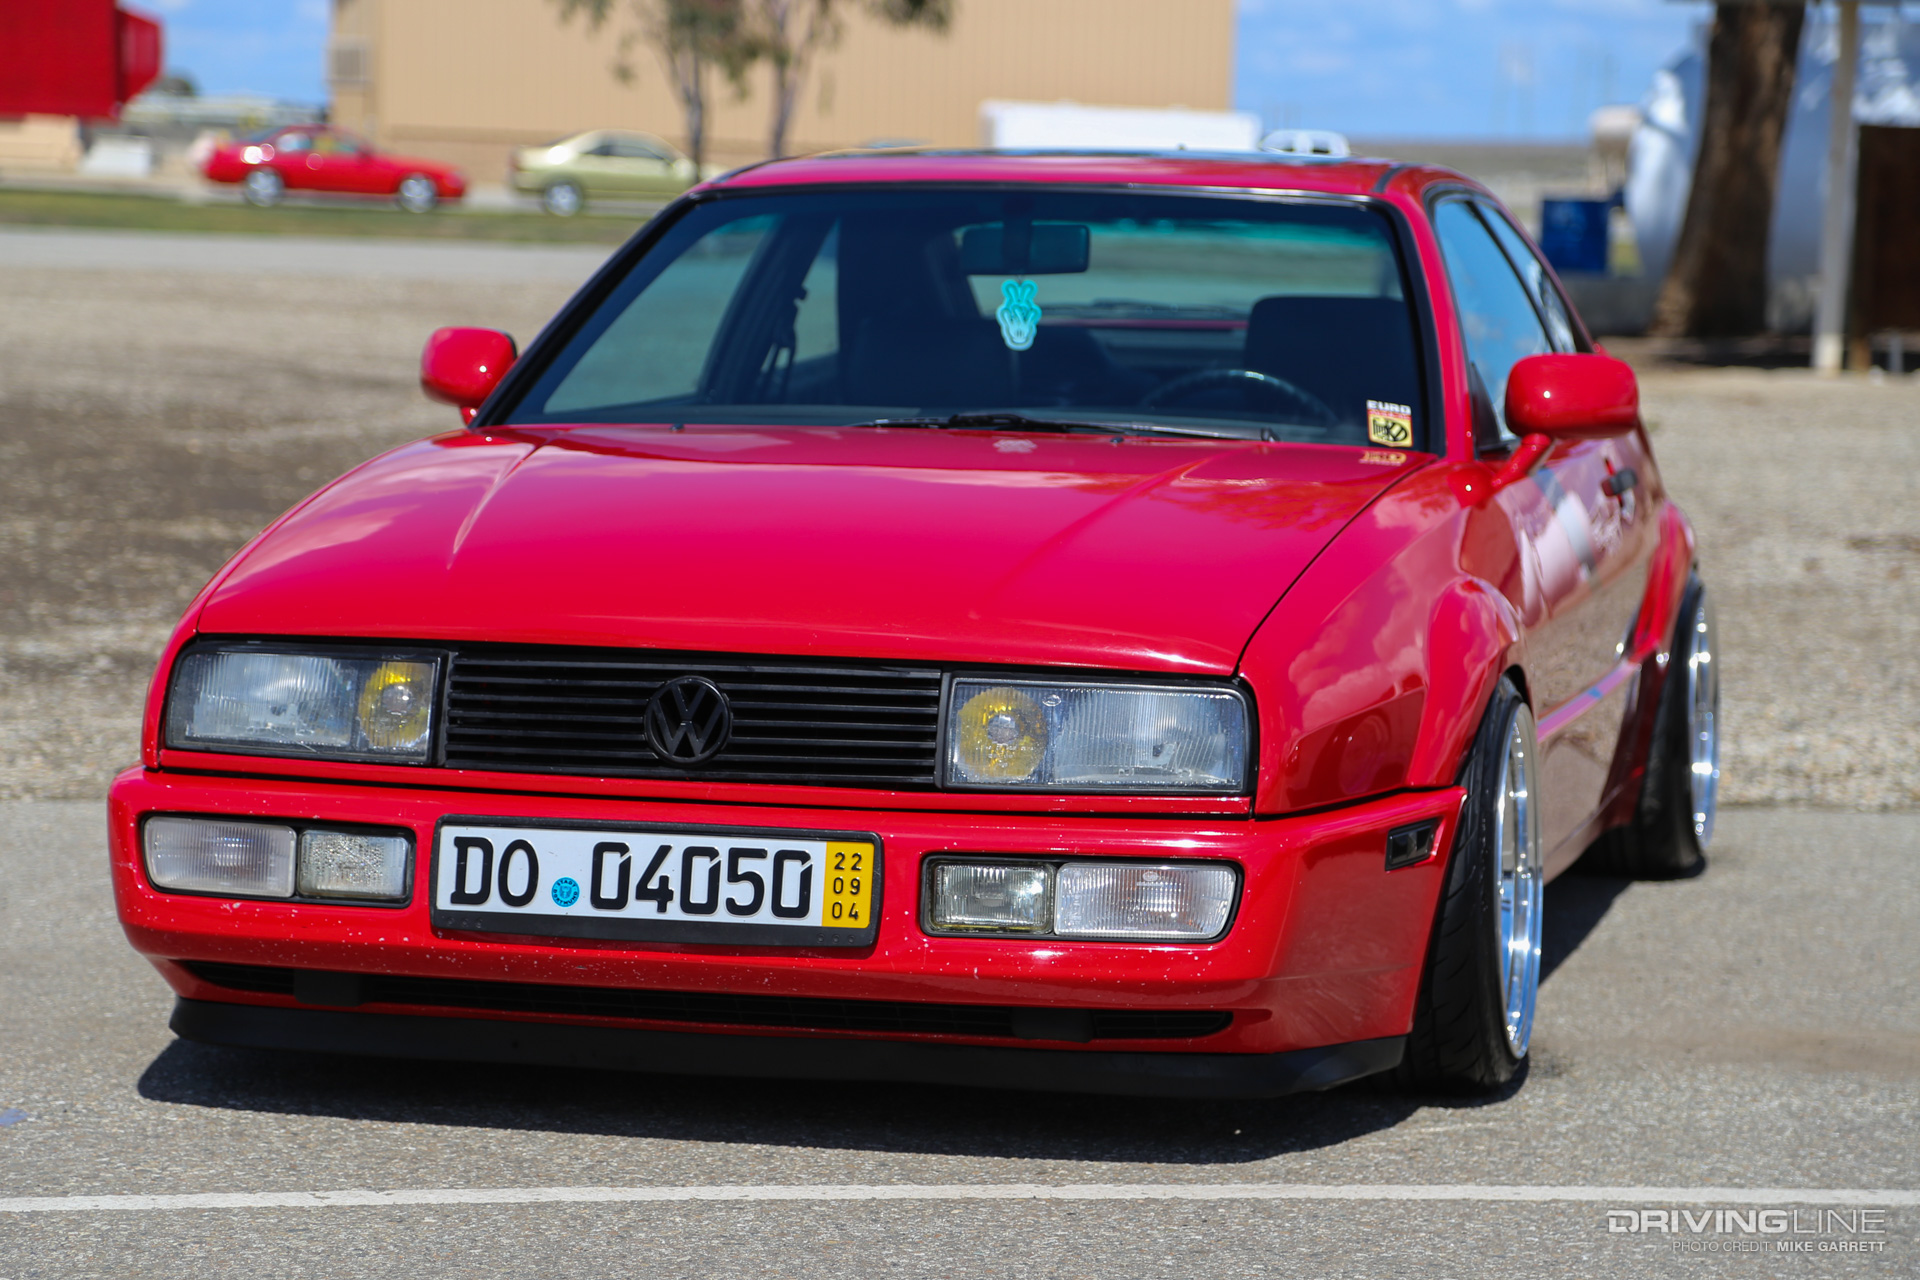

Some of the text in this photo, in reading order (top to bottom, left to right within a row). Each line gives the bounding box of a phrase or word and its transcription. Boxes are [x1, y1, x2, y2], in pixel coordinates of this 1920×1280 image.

[1366, 399, 1412, 415] EURO
[834, 851, 862, 871] 22
[450, 835, 814, 920] DO 04050
[833, 875, 861, 895] 09
[831, 901, 859, 921] 04
